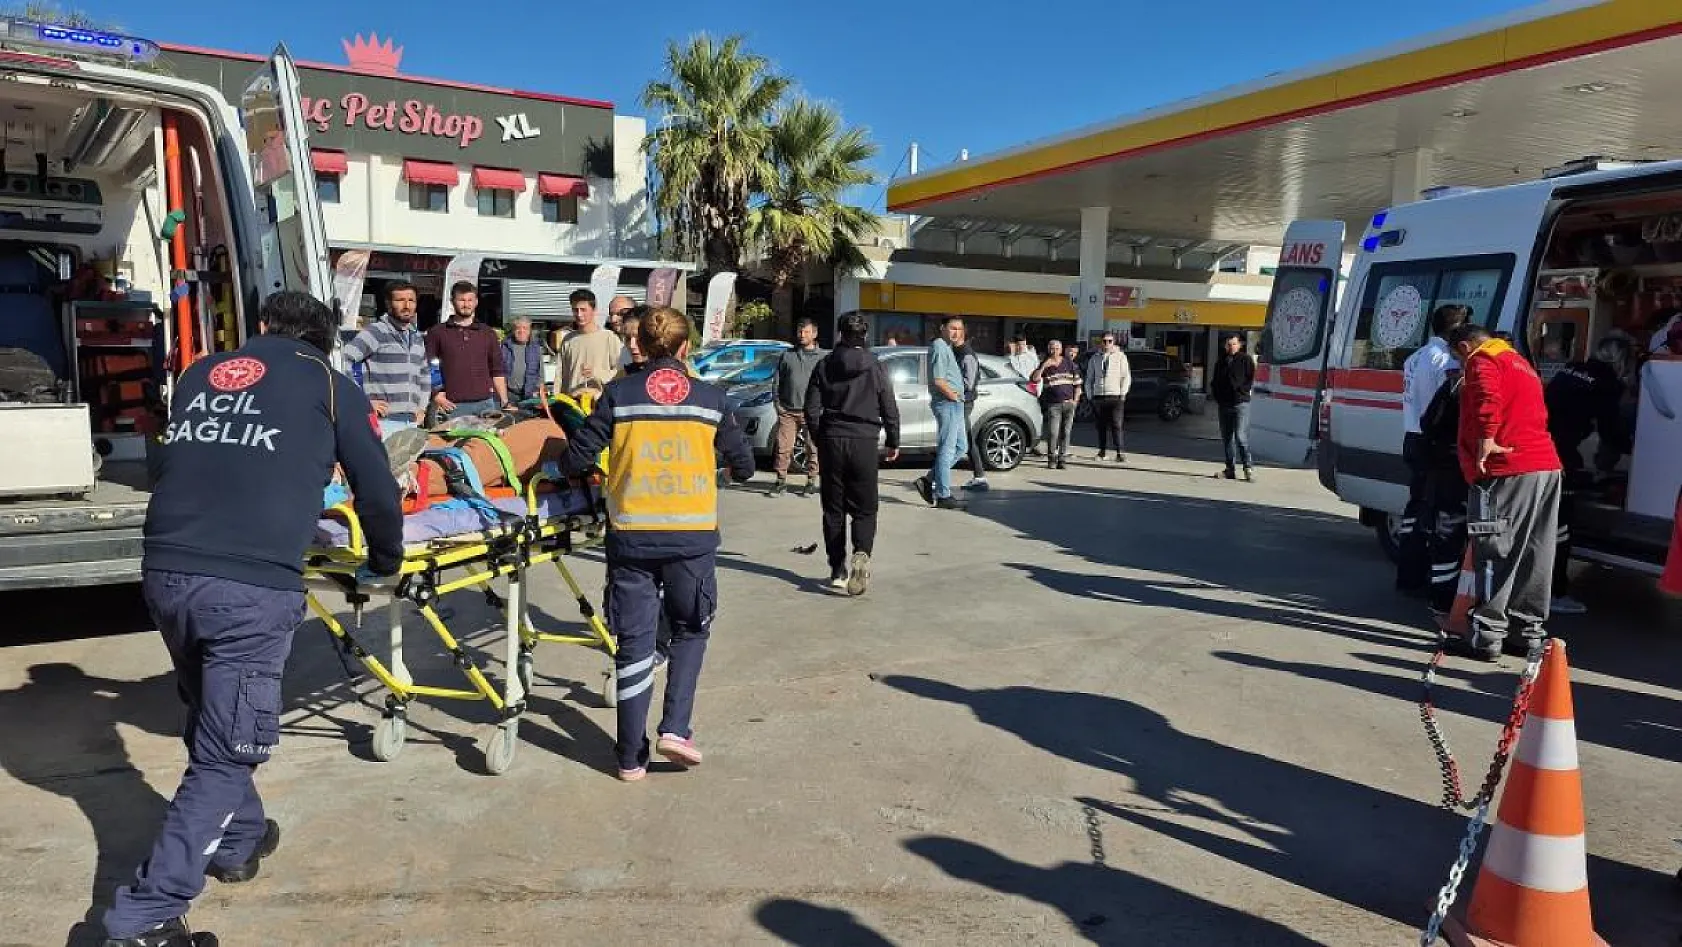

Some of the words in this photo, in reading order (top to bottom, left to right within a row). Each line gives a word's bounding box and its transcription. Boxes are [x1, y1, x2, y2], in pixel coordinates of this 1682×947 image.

[496, 112, 541, 142] XL
[185, 391, 262, 415] ACİL
[163, 416, 282, 451] SAĞLIK
